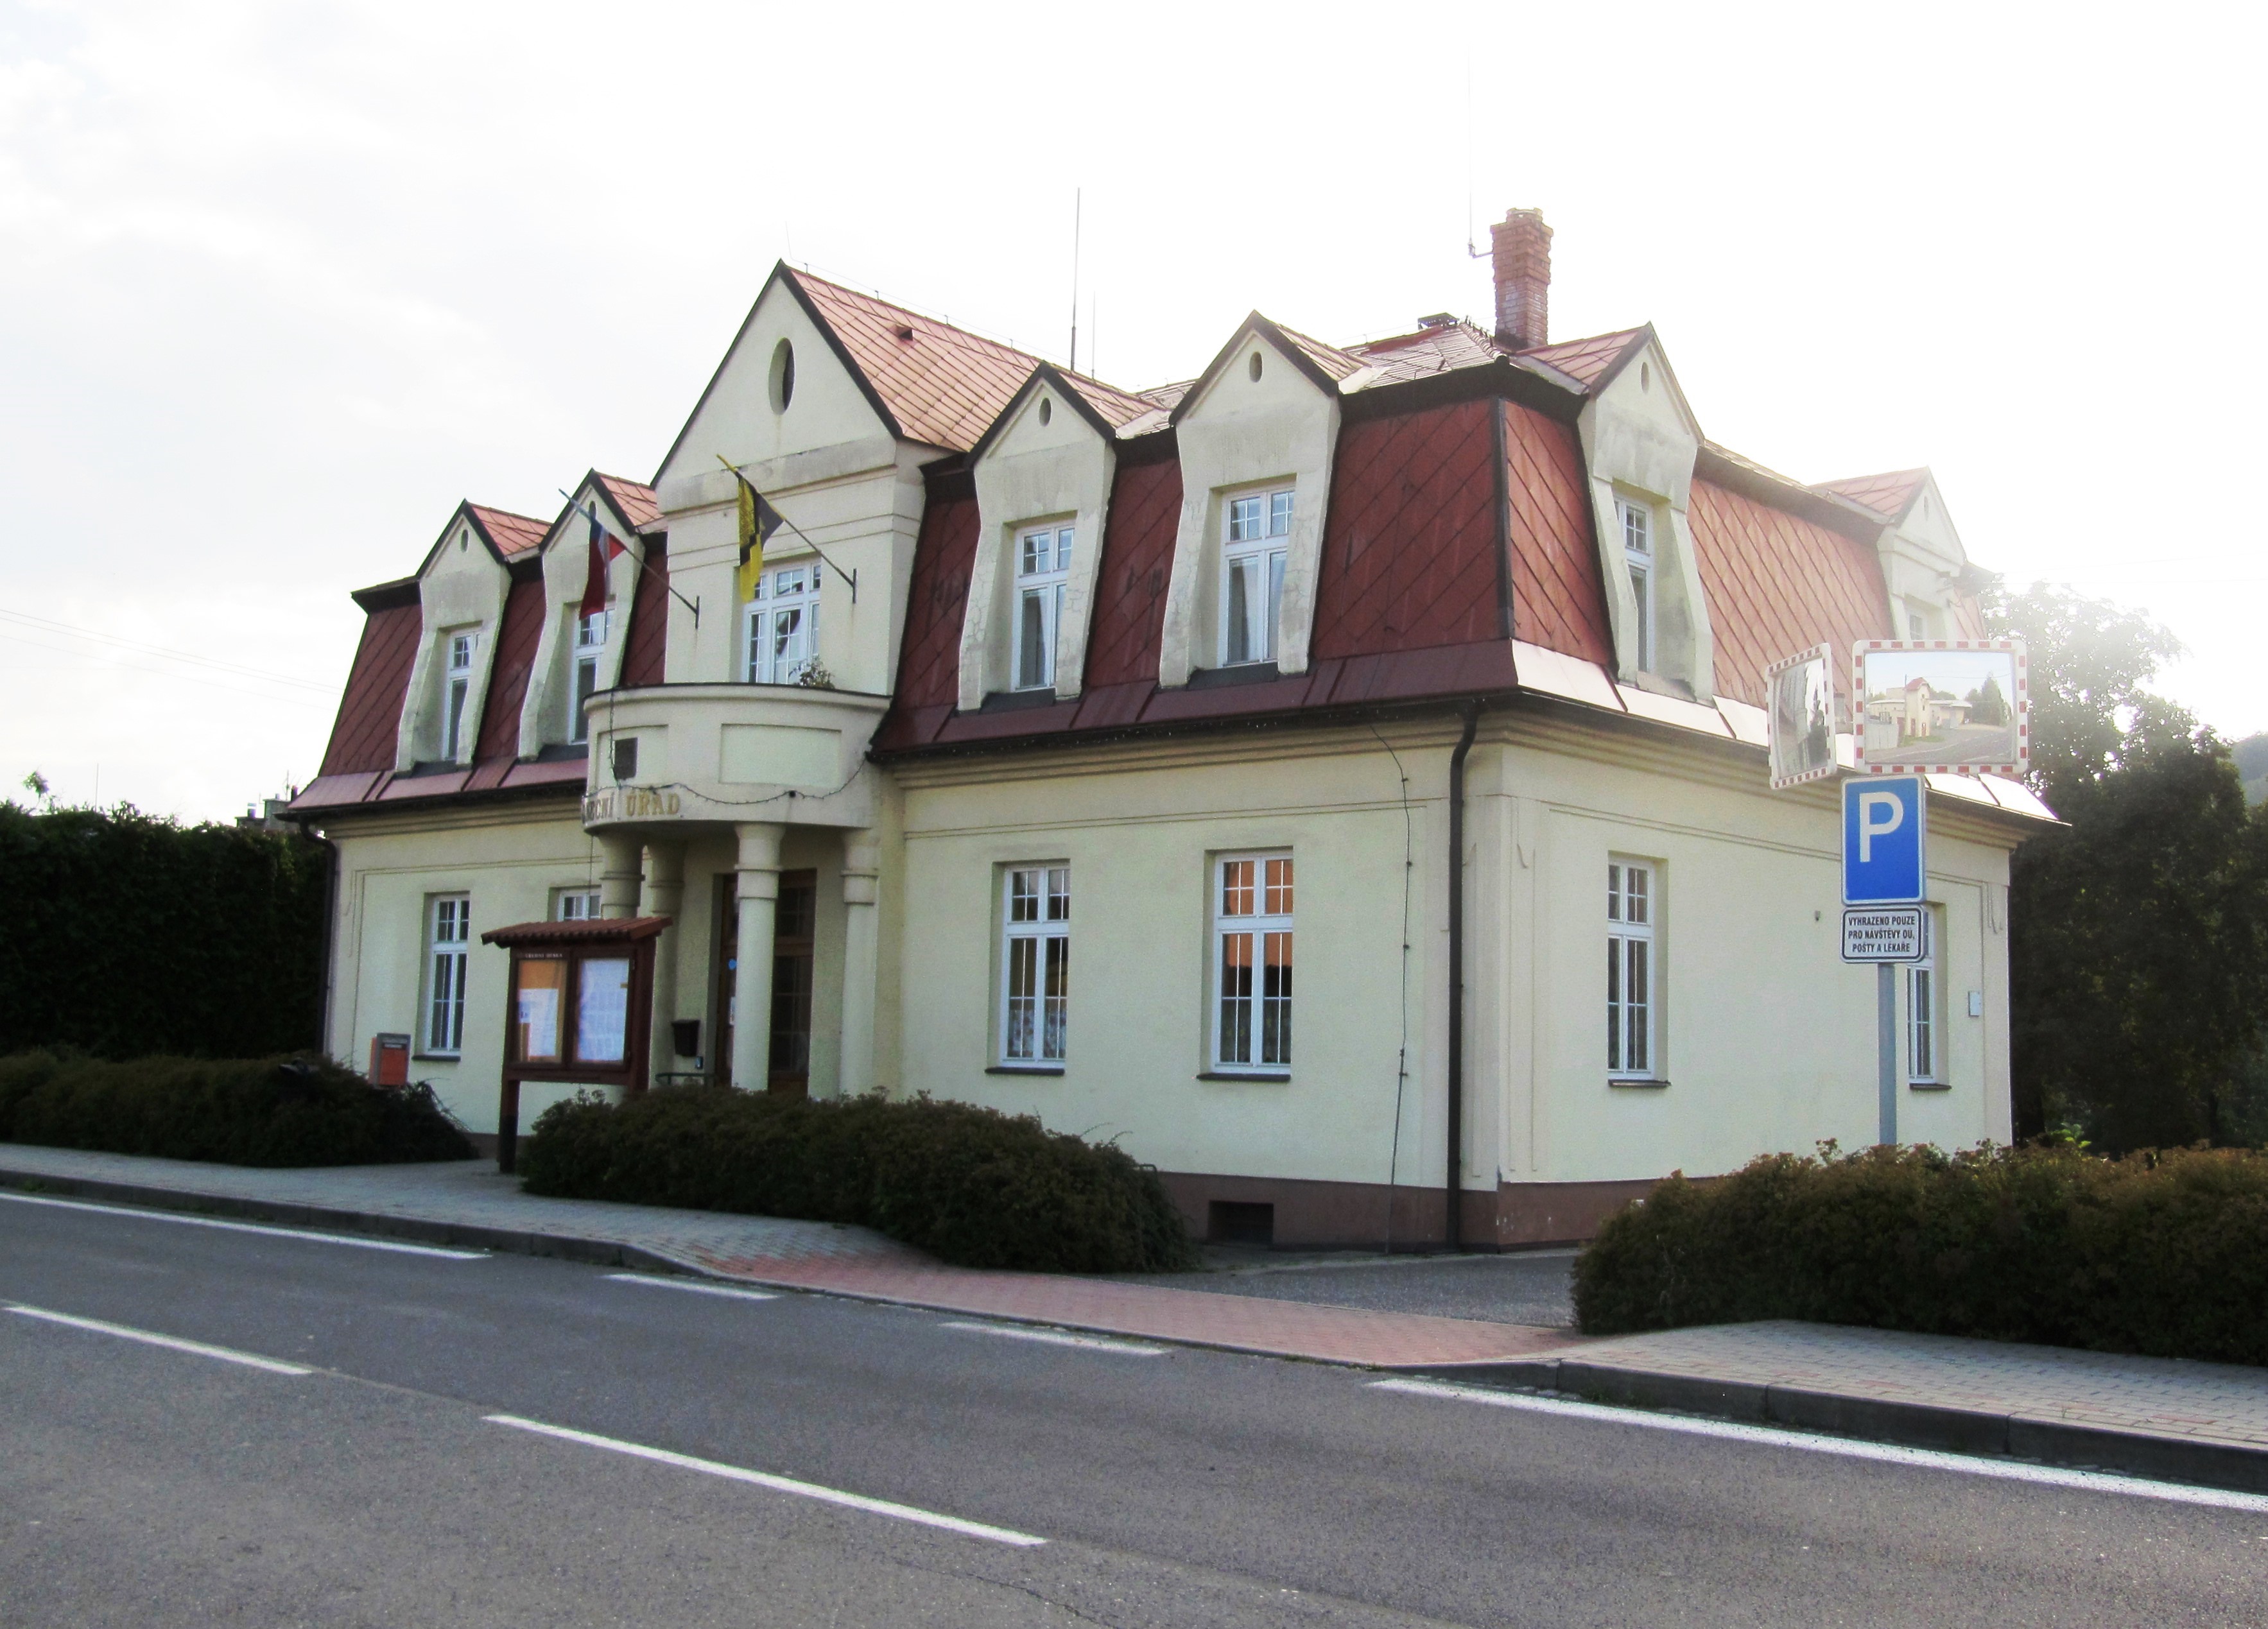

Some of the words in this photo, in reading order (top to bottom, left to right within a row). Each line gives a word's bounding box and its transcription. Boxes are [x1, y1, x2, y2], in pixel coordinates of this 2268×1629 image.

[1860, 791, 1903, 862] P
[1848, 917, 1889, 926] VYHRAZENO
[1892, 916, 1915, 924] POUZE
[1848, 930, 1862, 939] PRO
[1865, 927, 1901, 938] NÁVŠTĚVY
[1853, 942, 1874, 952] POŠTY
[1877, 944, 1882, 952] A
[1884, 941, 1910, 952] LÉKAŘE
